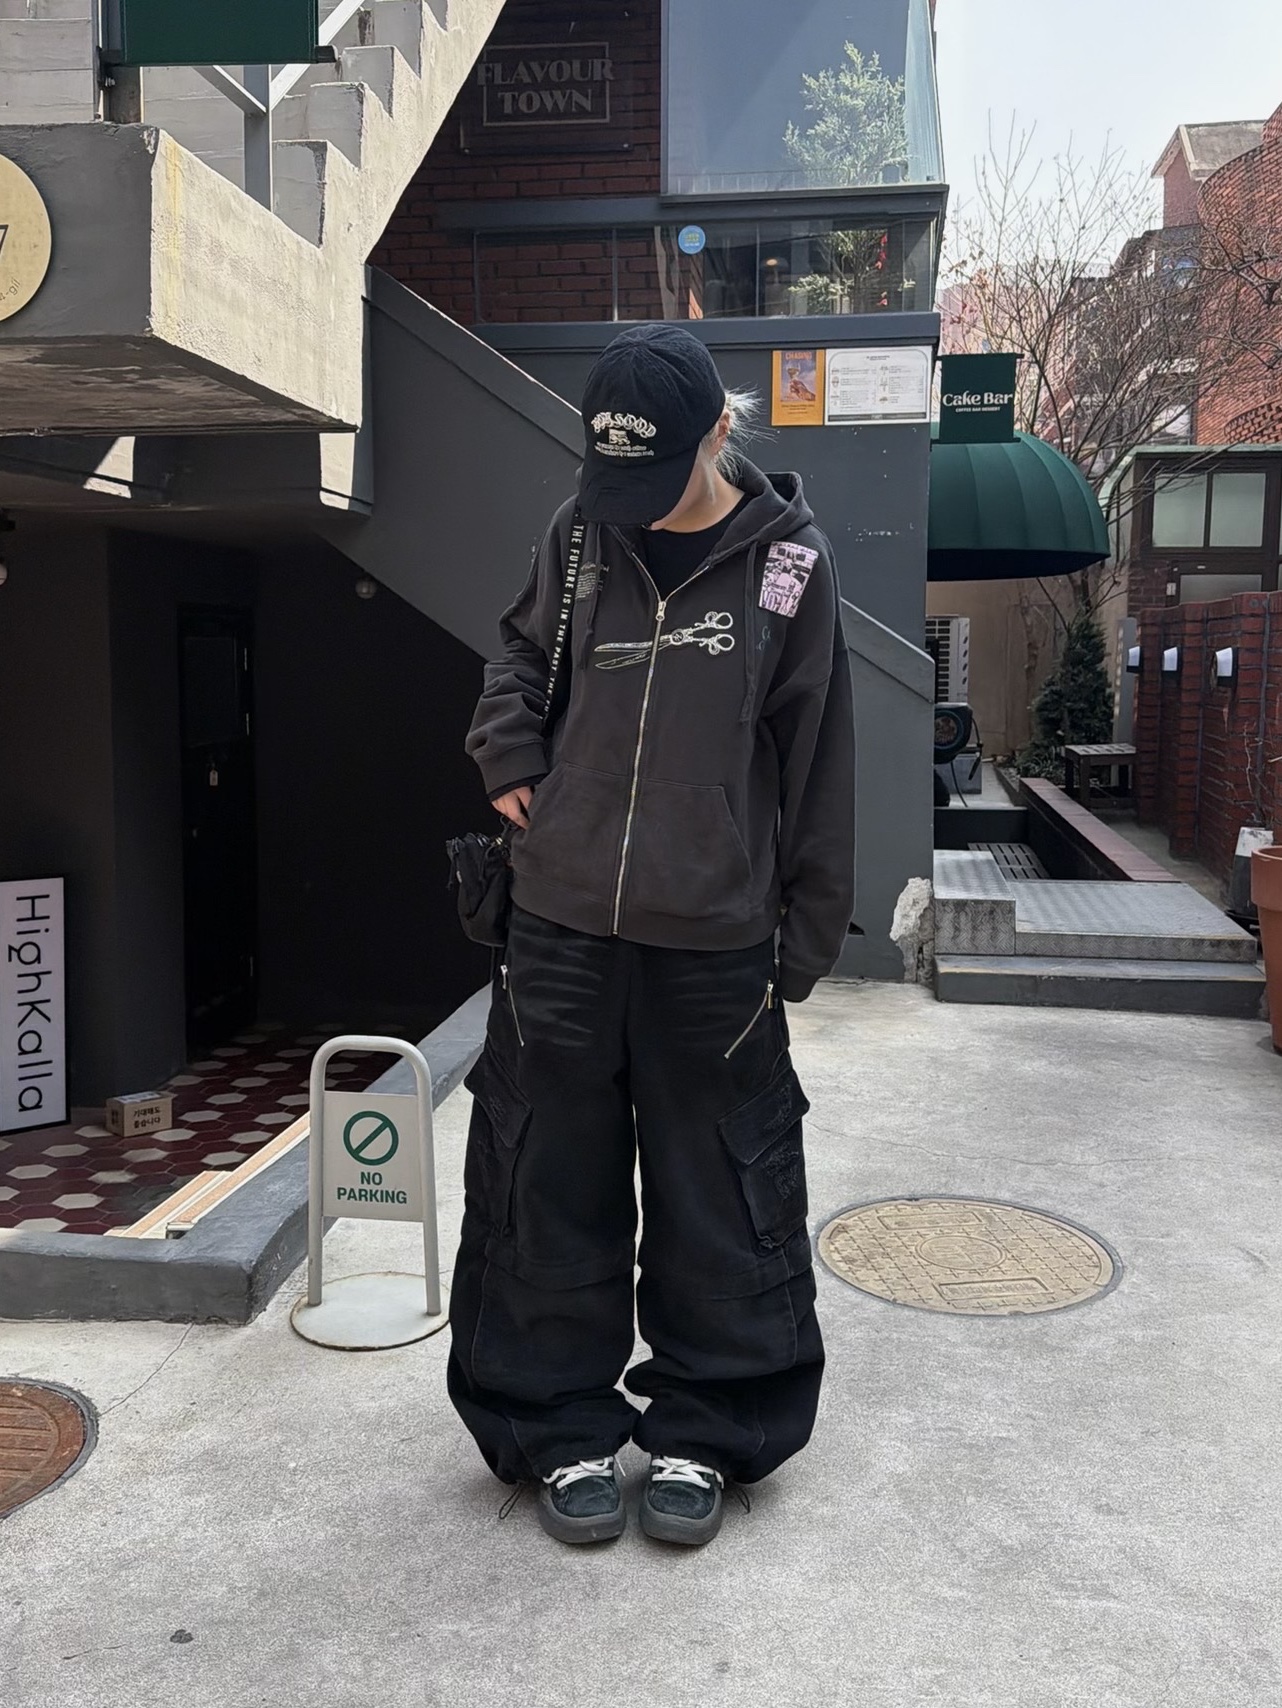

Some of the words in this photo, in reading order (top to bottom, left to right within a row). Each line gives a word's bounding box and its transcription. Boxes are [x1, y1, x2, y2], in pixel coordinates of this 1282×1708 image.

[477, 59, 615, 85] FLAVOUR
[498, 88, 592, 114] TOWN
[942, 390, 981, 407] Cake
[983, 391, 1013, 405] Bar
[571, 525, 584, 544] THE
[565, 548, 580, 589] FUTURE
[562, 594, 573, 604] IS
[560, 608, 569, 620] IN
[557, 624, 566, 642] THE
[551, 646, 561, 671] PAST
[547, 677, 556, 695] THE
[8, 894, 53, 1113] HighKalla
[360, 1171, 383, 1185] NO
[337, 1187, 407, 1204] PARKING
